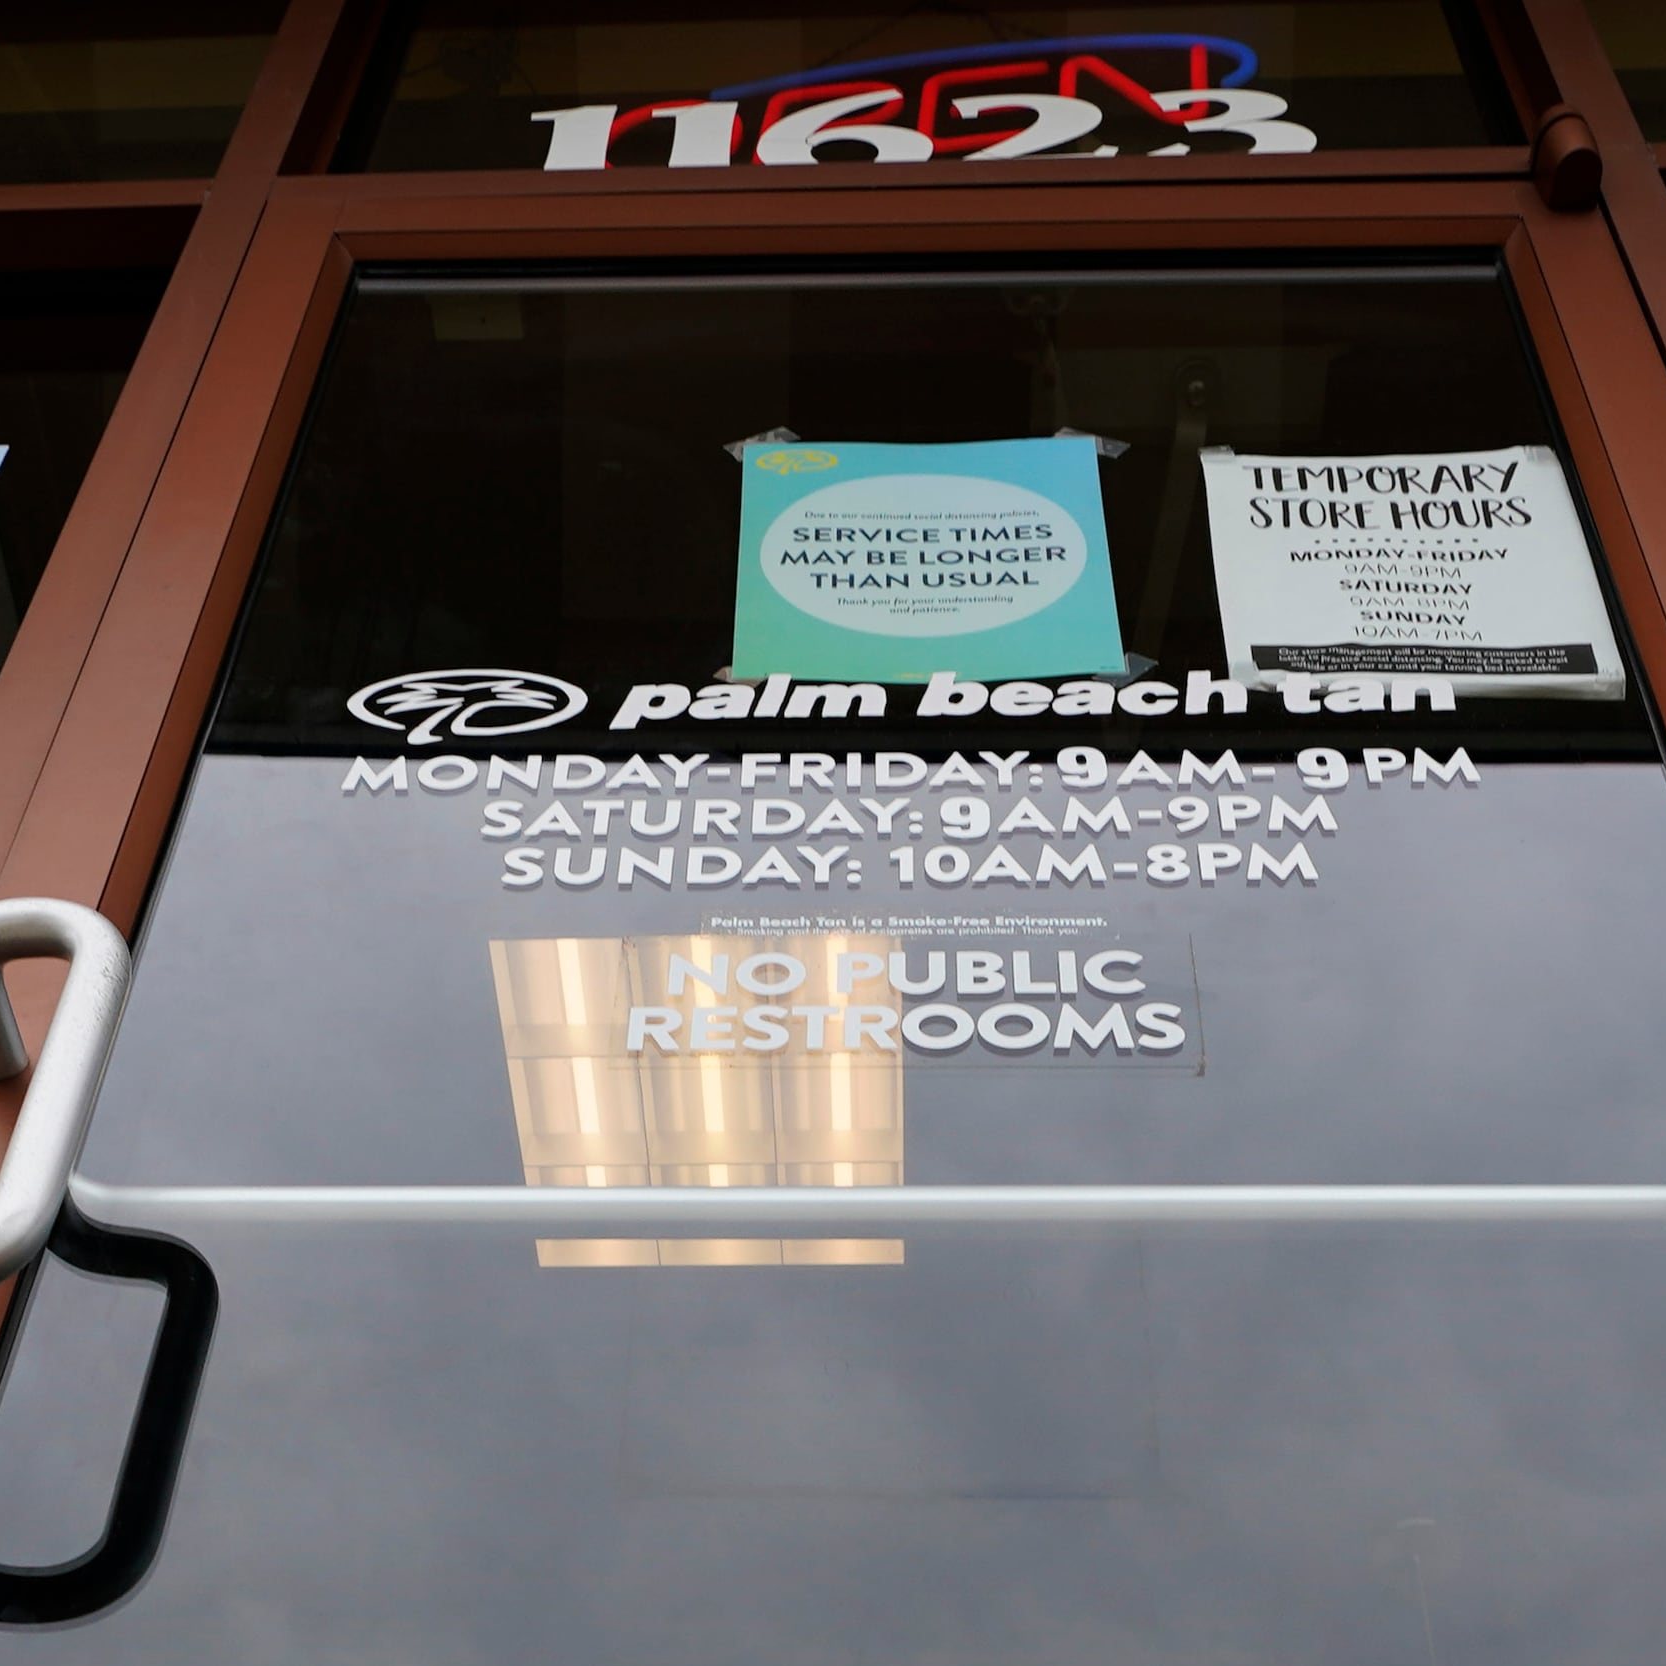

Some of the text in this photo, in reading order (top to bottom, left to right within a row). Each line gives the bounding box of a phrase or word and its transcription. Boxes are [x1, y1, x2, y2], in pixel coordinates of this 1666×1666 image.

[531, 88, 1317, 170] 11623
[1242, 461, 1519, 495] TEMPORARY
[1249, 496, 1533, 530] STORE HOURS
[792, 524, 1054, 544] SERVICE TIMES
[780, 546, 1067, 566] MAY BE LONGER
[1289, 548, 1509, 564] MONDAY-FRIDAY
[809, 571, 1039, 590] THAN USUAL
[1344, 563, 1463, 579] 9AM-9PM
[1339, 578, 1473, 596] SATURDAY
[1360, 610, 1467, 626] SUNDAY
[1351, 625, 1484, 642] 10AM-7PM
[609, 670, 1457, 731] palm beach tan
[341, 749, 1044, 791] MONDAY-FRIDAY:
[480, 795, 1339, 838] SATURDAY: 9AM-9PM
[500, 842, 1319, 887] SUNDAY: 10AM-8PM
[711, 916, 754, 928] Palm
[759, 916, 811, 928] Beach
[816, 916, 847, 928] Tan
[852, 916, 866, 928] is
[871, 917, 883, 928] a
[888, 915, 990, 928] Smoke-Free
[737, 927, 783, 938] Smoking
[937, 928, 956, 936] are
[1023, 926, 1054, 936] Thank
[667, 950, 1147, 996] NO PUBLIC
[626, 1001, 1187, 1052] RESTROOMS
